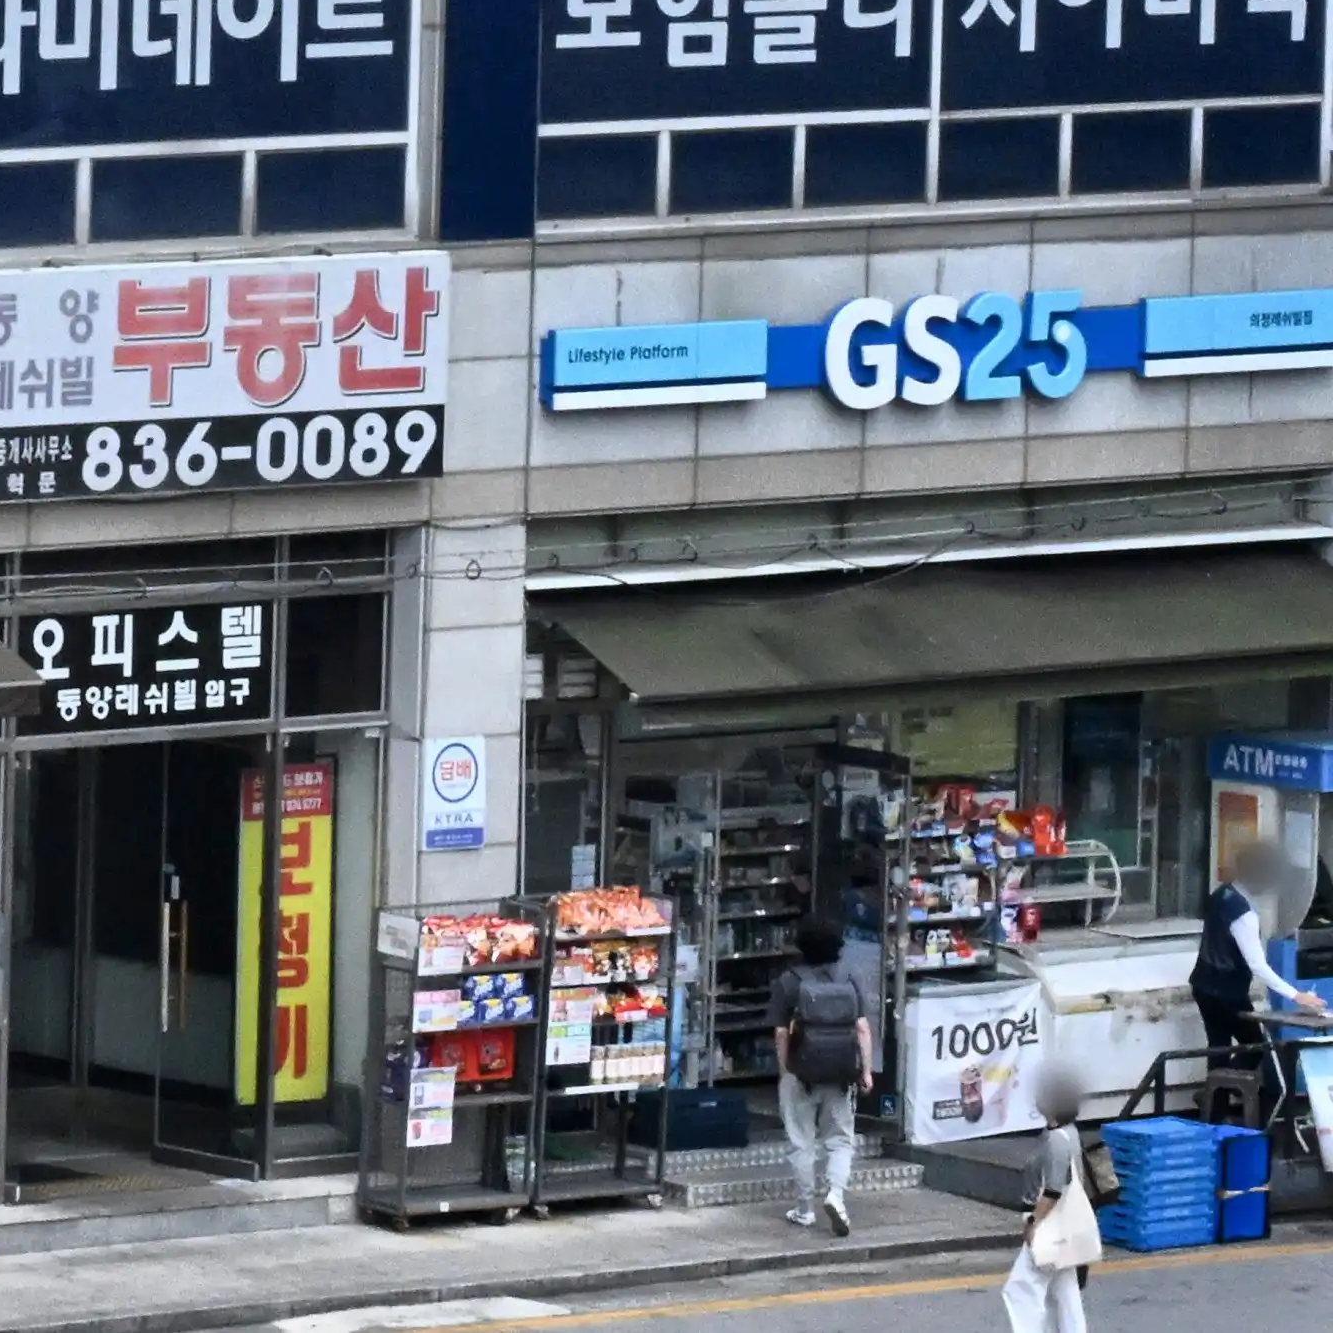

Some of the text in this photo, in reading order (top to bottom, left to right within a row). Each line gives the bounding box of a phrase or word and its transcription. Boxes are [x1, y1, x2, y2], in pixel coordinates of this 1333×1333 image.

[112, 266, 440, 408] 부동산
[568, 343, 690, 366] Lifestyle Platform
[824, 288, 1089, 412] GS25
[80, 409, 438, 494] 836-0089
[32, 604, 264, 683] 오피스텔
[55, 676, 251, 723] 동양레쉬빌 입구
[440, 759, 473, 782] 담배
[1223, 743, 1274, 777] ATM
[931, 1006, 1039, 1061] 1000원
